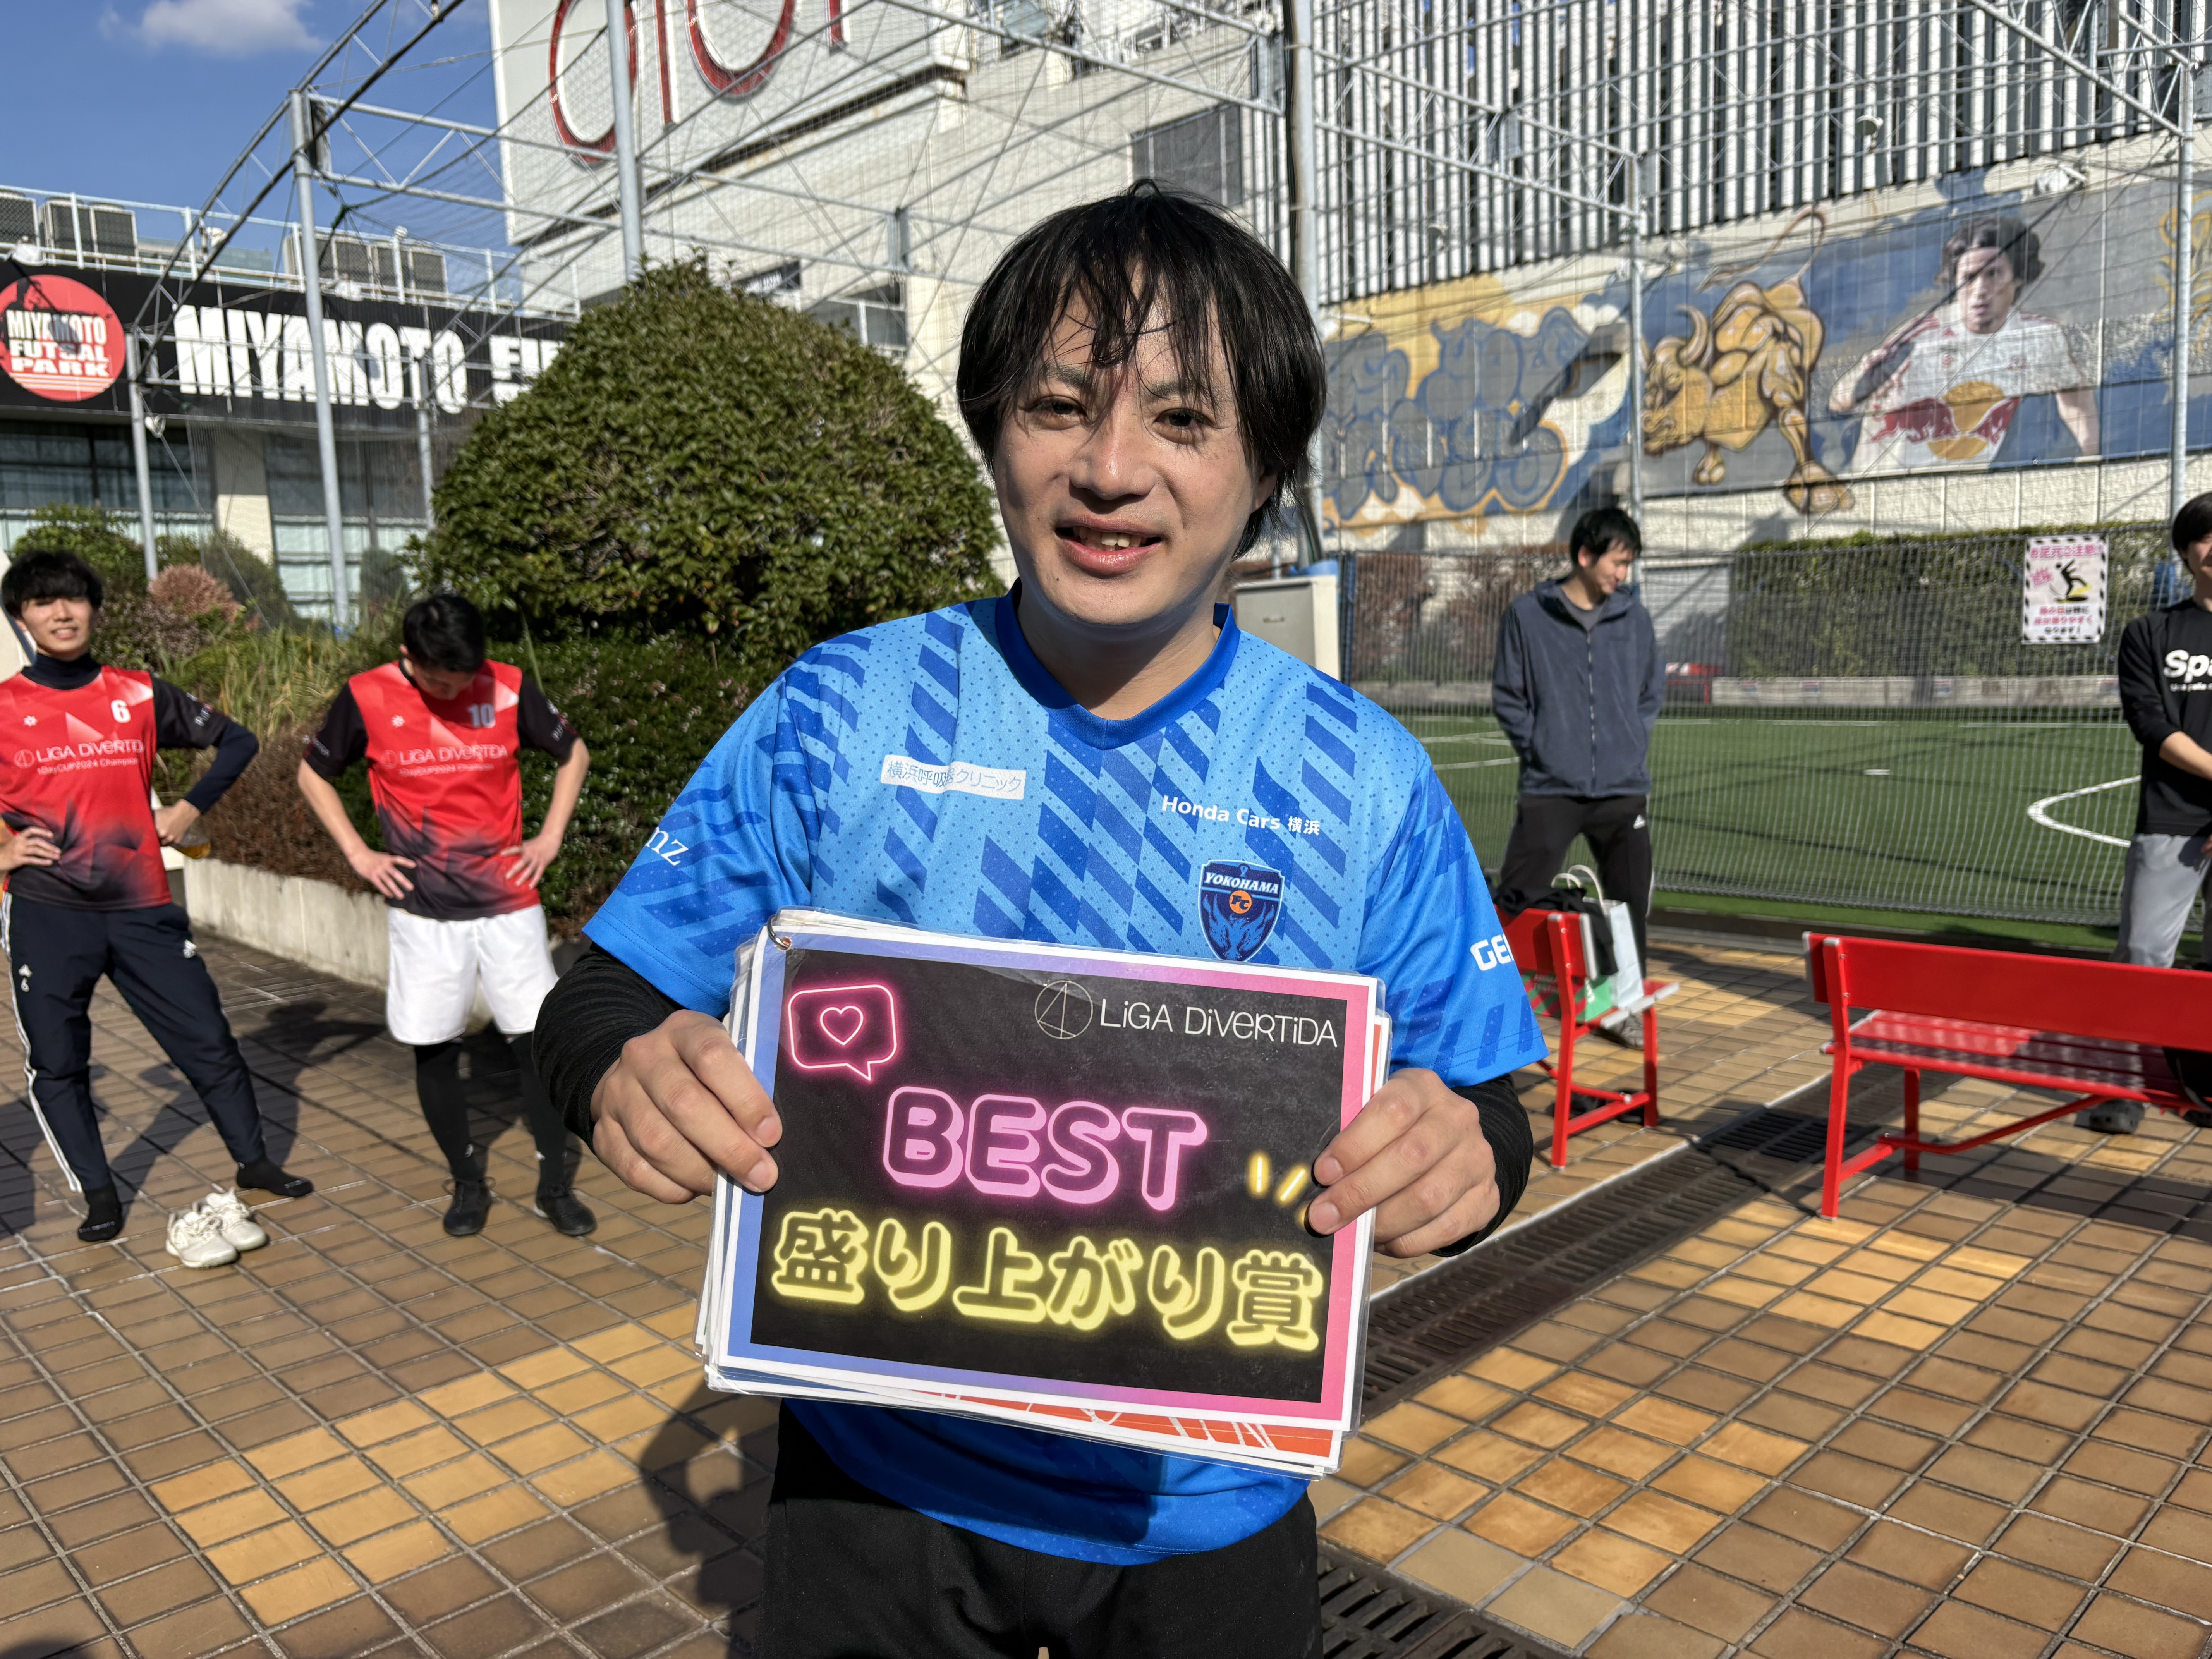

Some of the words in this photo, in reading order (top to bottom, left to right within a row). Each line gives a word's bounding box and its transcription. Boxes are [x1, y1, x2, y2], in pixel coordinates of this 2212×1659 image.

[6, 309, 107, 345] MIYAMOTO
[10, 339, 110, 362] FUTSAL
[174, 305, 467, 414] MIYAMOTO
[11, 357, 110, 377] PARK
[2163, 649, 2212, 683] Sp
[110, 699, 131, 723] 6
[468, 703, 496, 728] 10
[887, 761, 1022, 792] 横浜呼吸器クリニック
[1161, 795, 1229, 822] Honda
[1237, 808, 1281, 830] Cars
[1287, 815, 1320, 835] 横浜
[1204, 872, 1279, 895] YOKOHAMA
[1231, 895, 1250, 910] FC
[1470, 933, 1515, 971] GE
[882, 1086, 1207, 1211] BEST
[771, 1207, 1323, 1352] 盛り上がり賞
